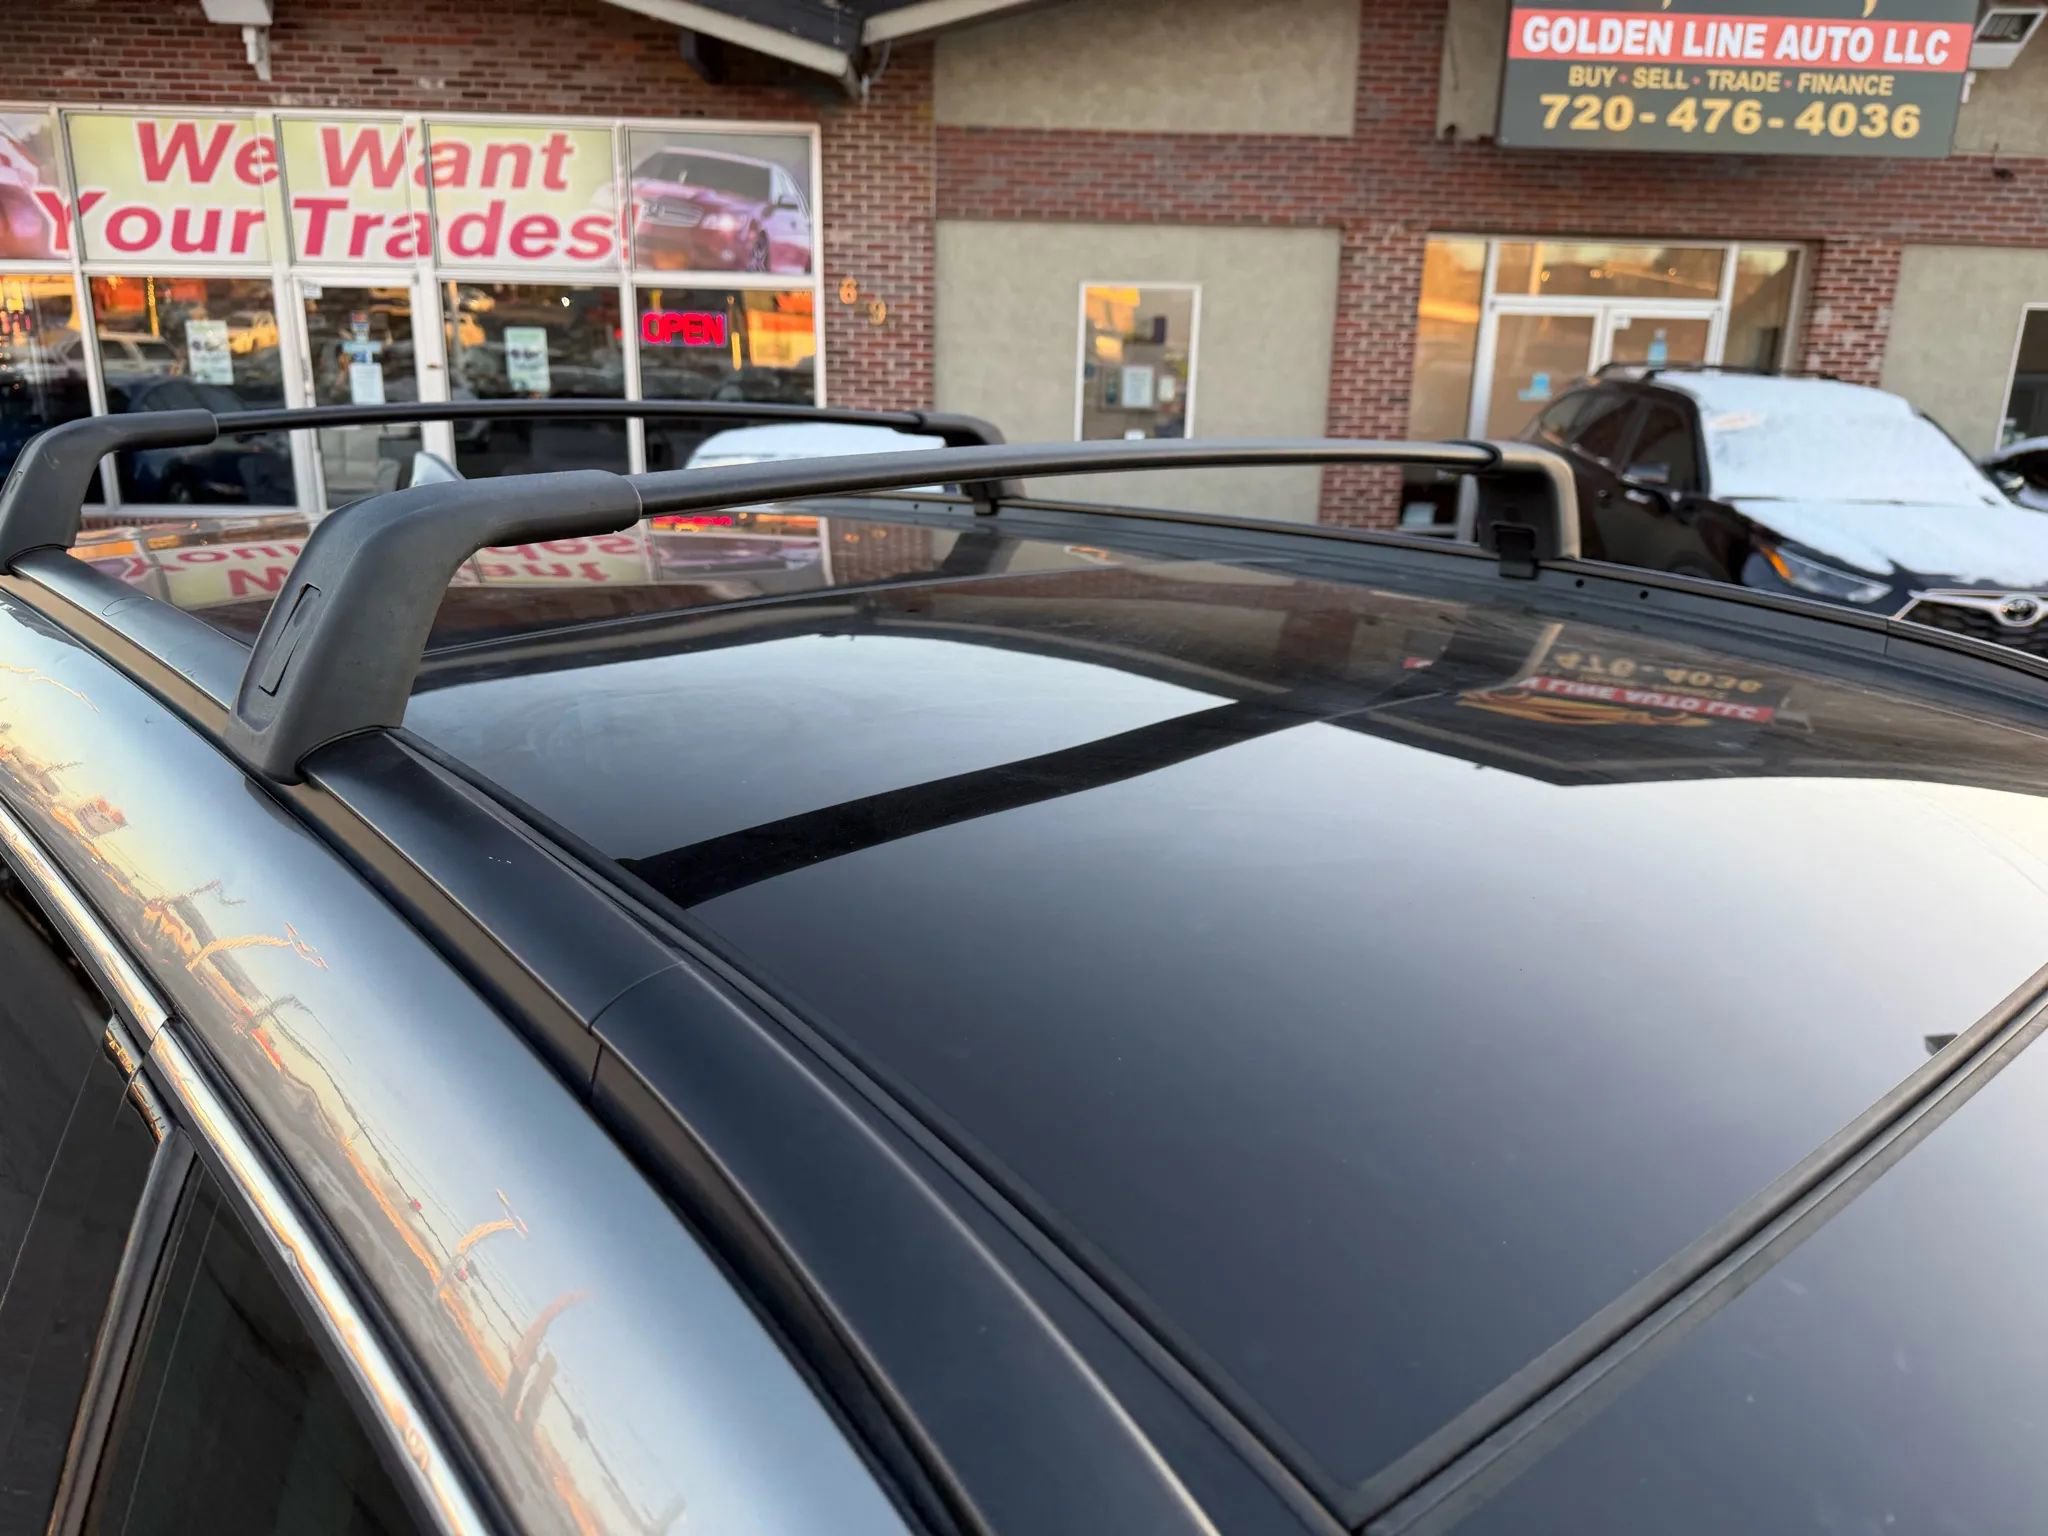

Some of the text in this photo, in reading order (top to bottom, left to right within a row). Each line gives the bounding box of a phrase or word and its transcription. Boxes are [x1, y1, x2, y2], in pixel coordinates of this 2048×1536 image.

[1522, 16, 1950, 66] GOLDEN LINE AUTO LLC
[1568, 65, 1895, 97] BUY SELL TRADE FINANCE
[1540, 93, 1921, 139] 720-476-4036
[136, 121, 574, 190] We Want
[34, 191, 639, 261] Your Trades!
[642, 311, 727, 347] OPEN
